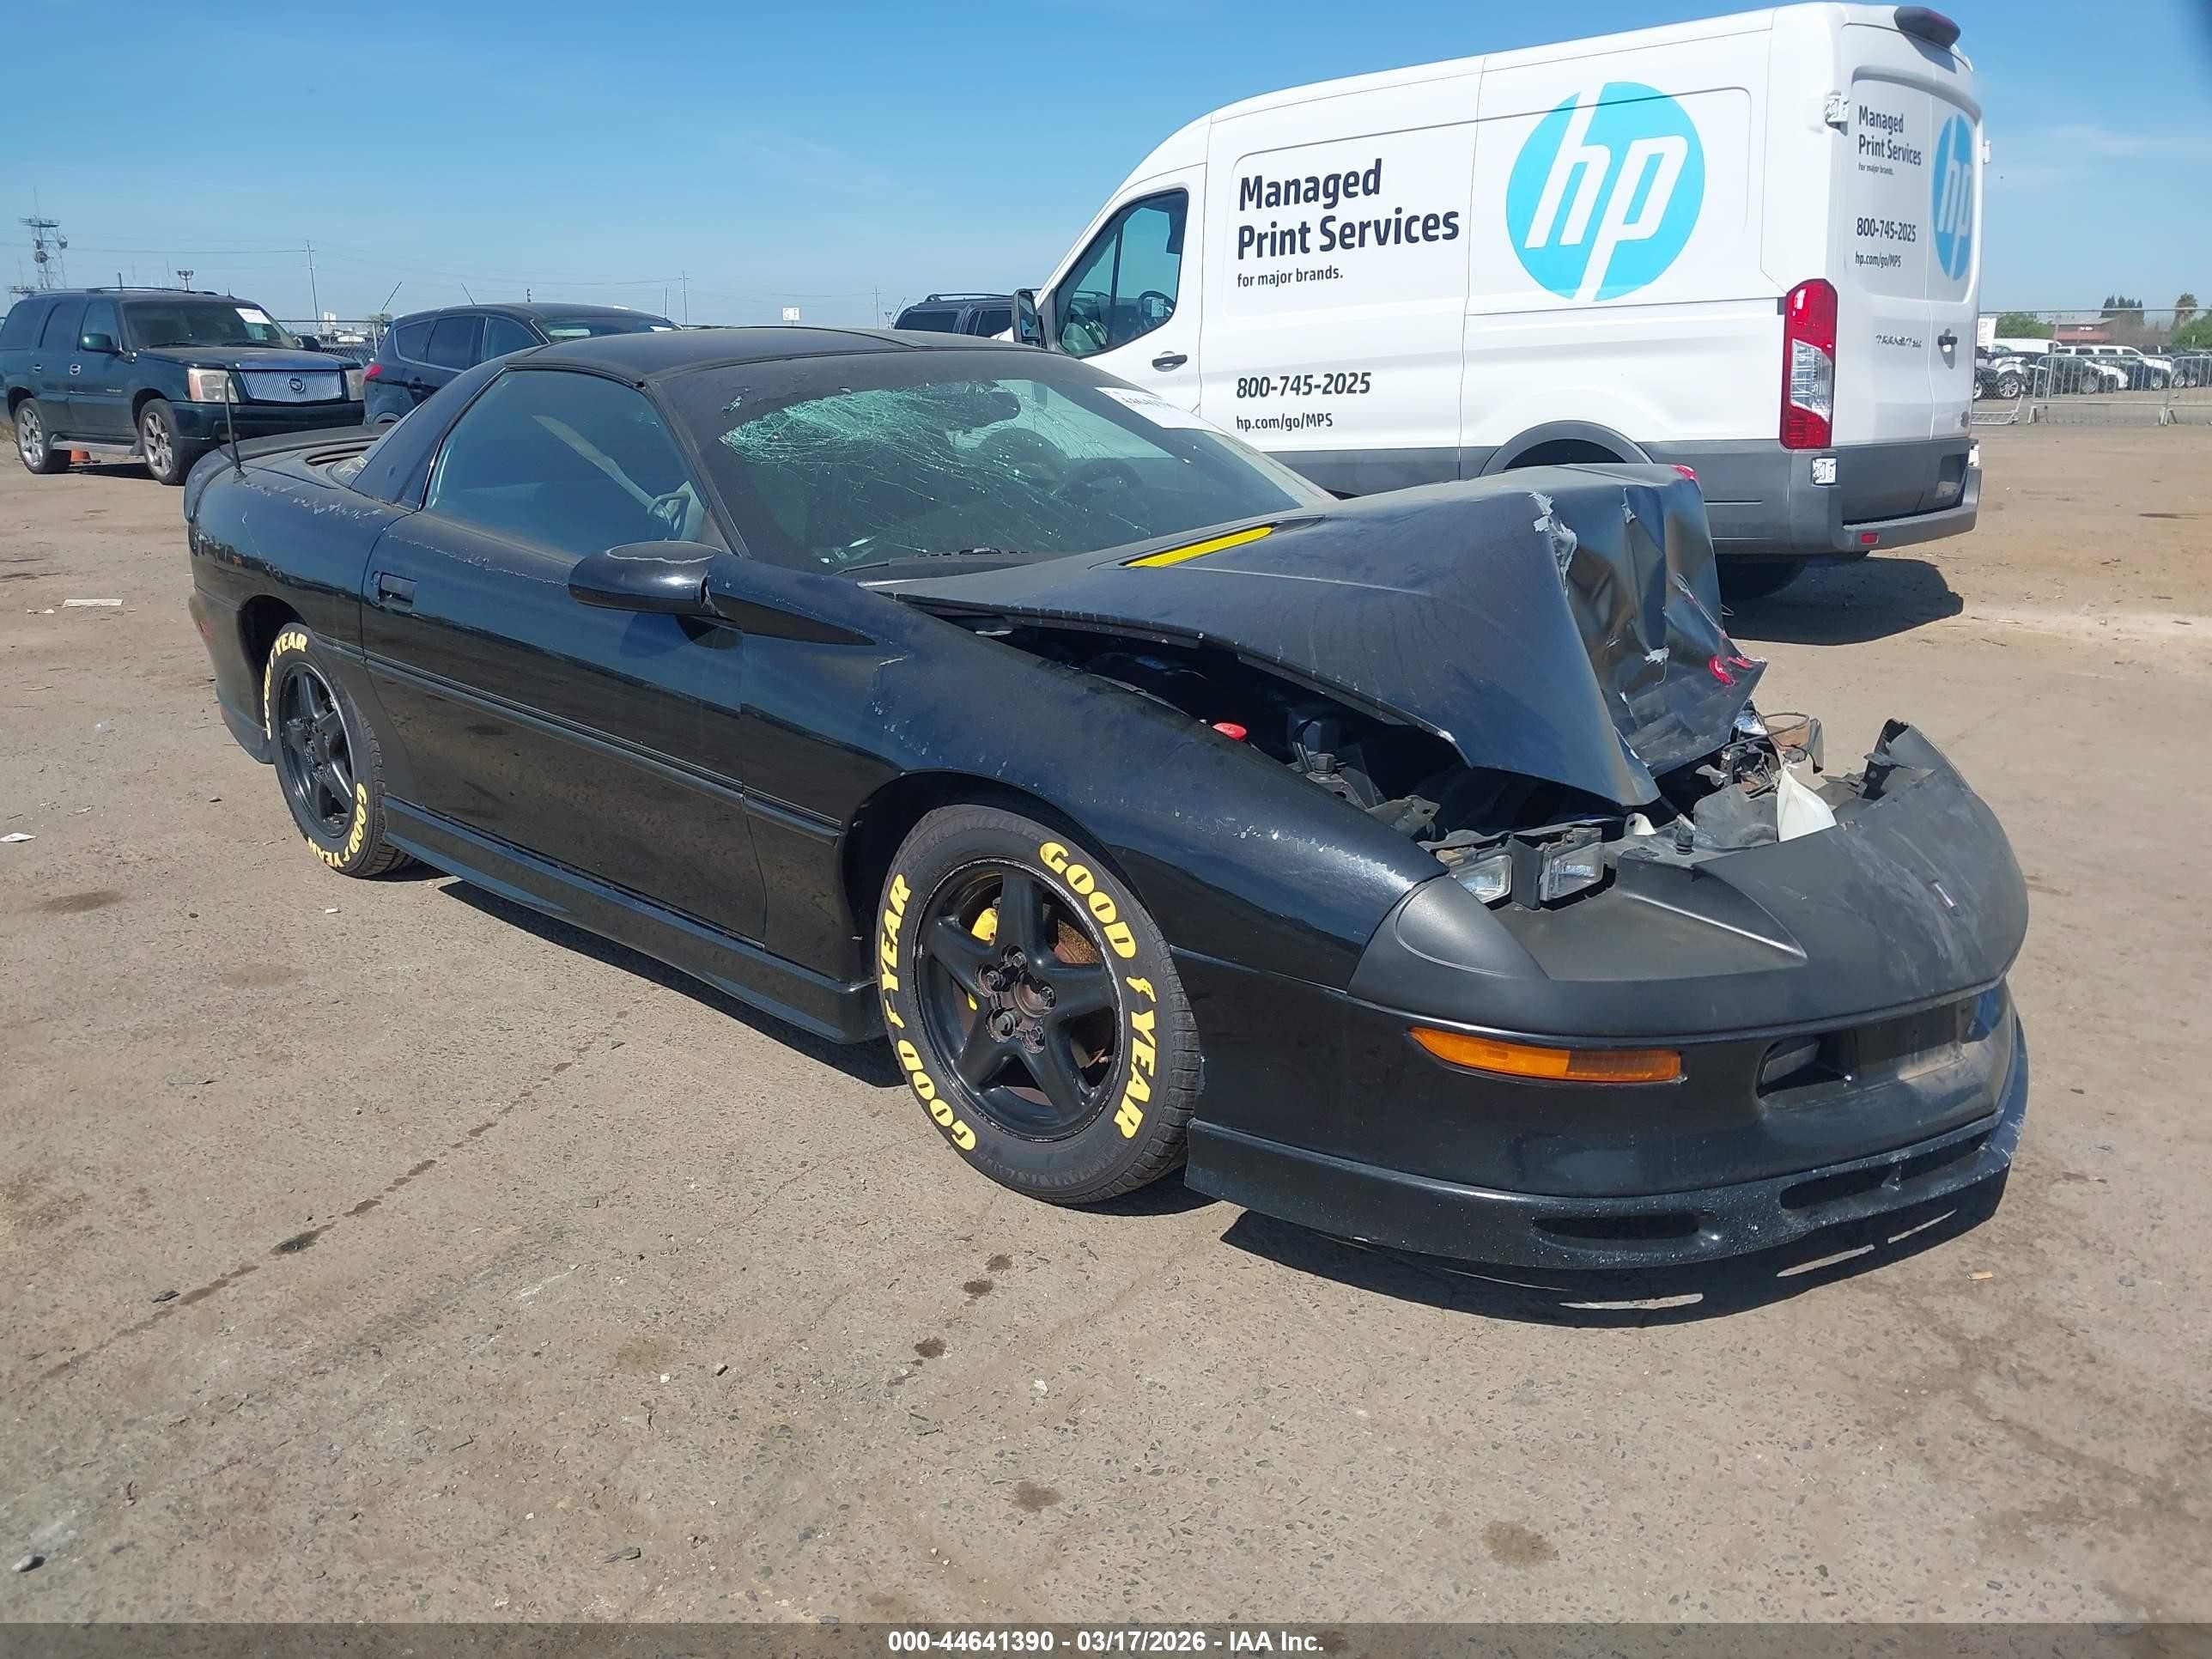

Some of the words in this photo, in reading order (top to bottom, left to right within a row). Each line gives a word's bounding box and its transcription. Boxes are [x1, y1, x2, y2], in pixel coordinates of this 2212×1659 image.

[1858, 105, 1904, 135] Managed
[1858, 134, 1885, 159] Print
[1887, 139, 1922, 166] Services
[1239, 158, 1382, 211] Managed
[1523, 83, 1689, 301] hp
[1237, 221, 1310, 260] Print
[1319, 207, 1459, 252] Services
[1856, 217, 1917, 242] 800-745-2025
[1856, 251, 1902, 269] hp.com/go/MPS
[1237, 273, 1255, 288] for
[1258, 270, 1292, 287] major
[1296, 265, 1343, 282] brands.
[1237, 372, 1371, 398] 800-745-2025
[1237, 412, 1333, 432] hp.com/go/MPS
[275, 632, 307, 657] YEAR
[349, 782, 368, 854] GOOD
[881, 873, 912, 992] YEAR
[1039, 842, 1138, 958] GOOD
[1114, 1010, 1158, 1139] YEAR
[897, 1039, 976, 1152] GOOD
